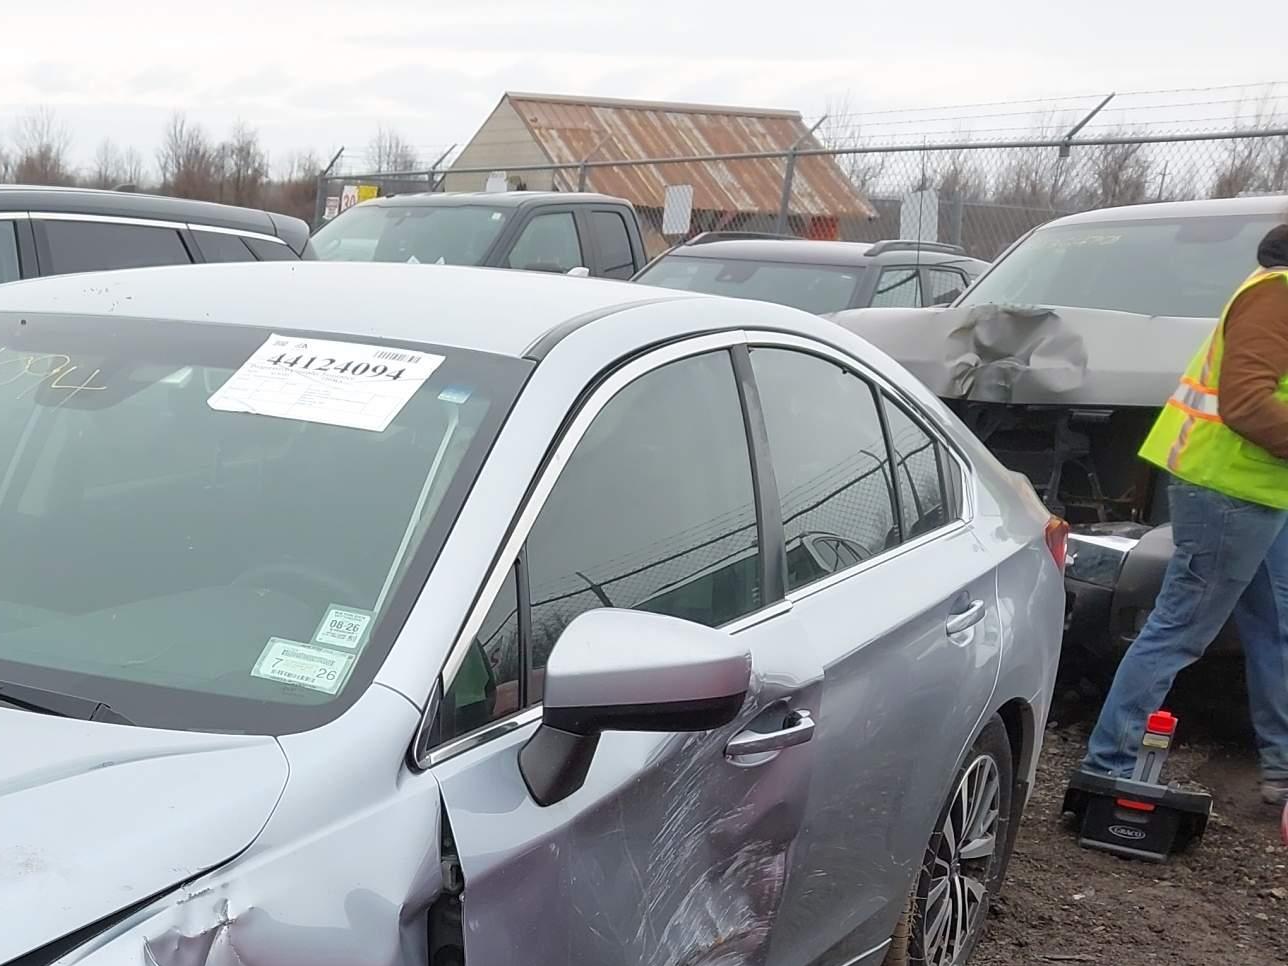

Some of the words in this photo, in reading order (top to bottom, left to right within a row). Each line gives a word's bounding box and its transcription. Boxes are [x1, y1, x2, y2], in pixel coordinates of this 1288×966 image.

[267, 353, 407, 381] 44124094
[270, 657, 284, 668] 7
[316, 668, 337, 680] 26
